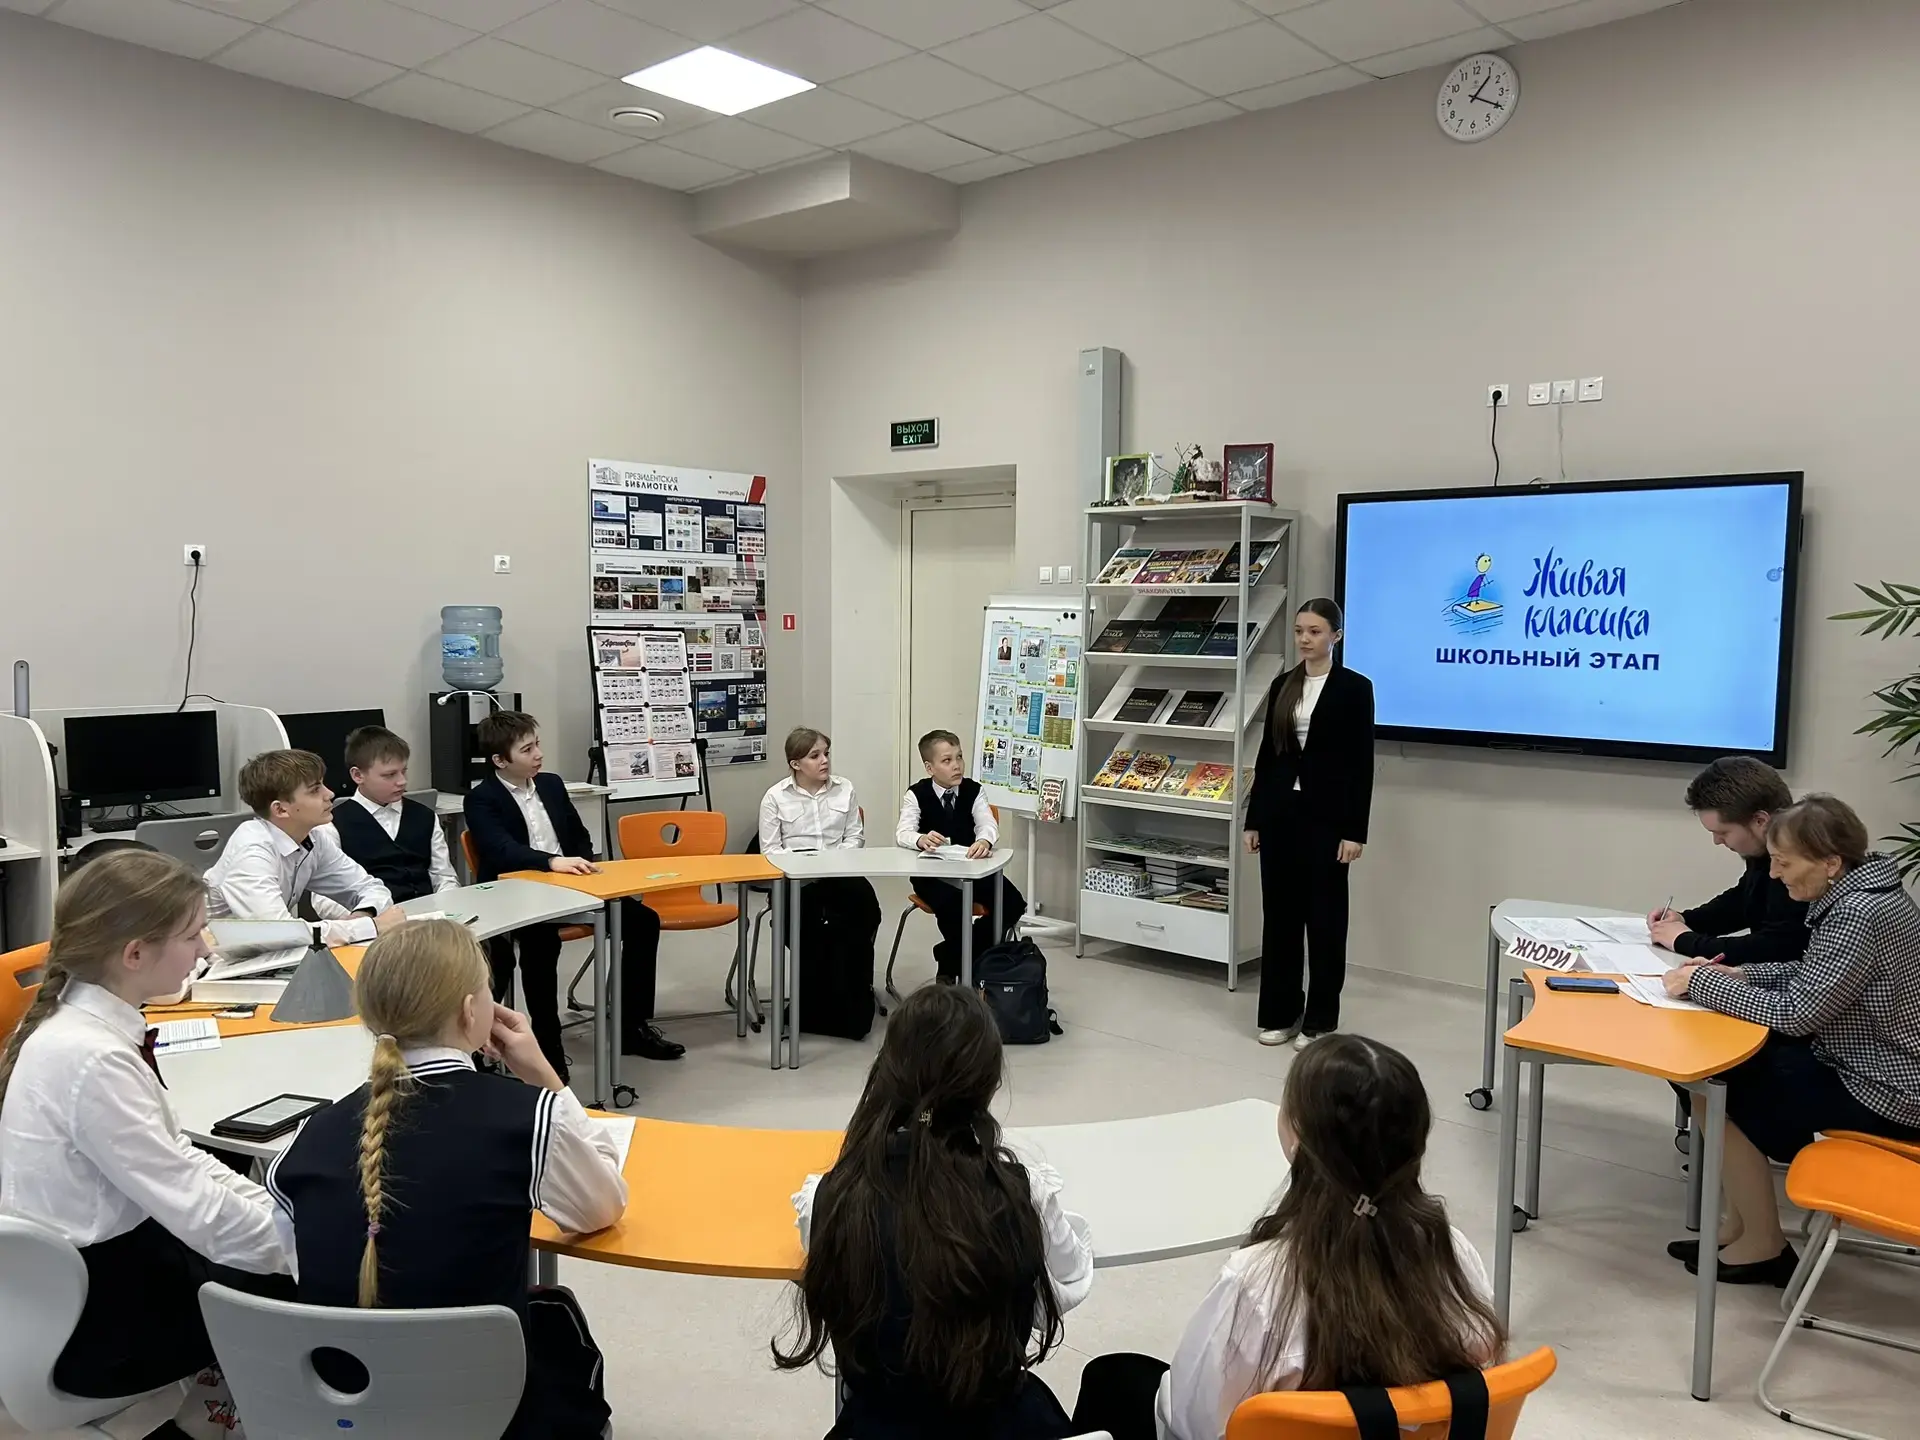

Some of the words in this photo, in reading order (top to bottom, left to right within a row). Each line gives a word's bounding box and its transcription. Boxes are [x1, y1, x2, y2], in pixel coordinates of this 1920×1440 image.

[1473, 66, 1481, 75] 12
[1461, 72, 1468, 82] 11
[1495, 75, 1501, 84] 2
[1452, 84, 1460, 93] 10
[1498, 87, 1504, 96] 3
[1446, 99, 1452, 107] 9
[1450, 110, 1456, 119] 8
[1485, 113, 1491, 122] 5
[1457, 119, 1464, 128] 7
[1470, 120, 1476, 129] 6
[896, 423, 930, 434] ВЫХОД
[902, 434, 922, 444] EXIT
[625, 472, 679, 484] ПРЕЗИДЕНТСКАЯ
[625, 481, 679, 492] БИБЛИОТЕКА
[1523, 546, 1626, 599] Живая
[1524, 604, 1650, 642] классика
[1436, 647, 1580, 668] ШКОЛЬНЫЙ
[1589, 652, 1660, 671] ЭТАП
[1510, 936, 1572, 969] ЖЮРИ
